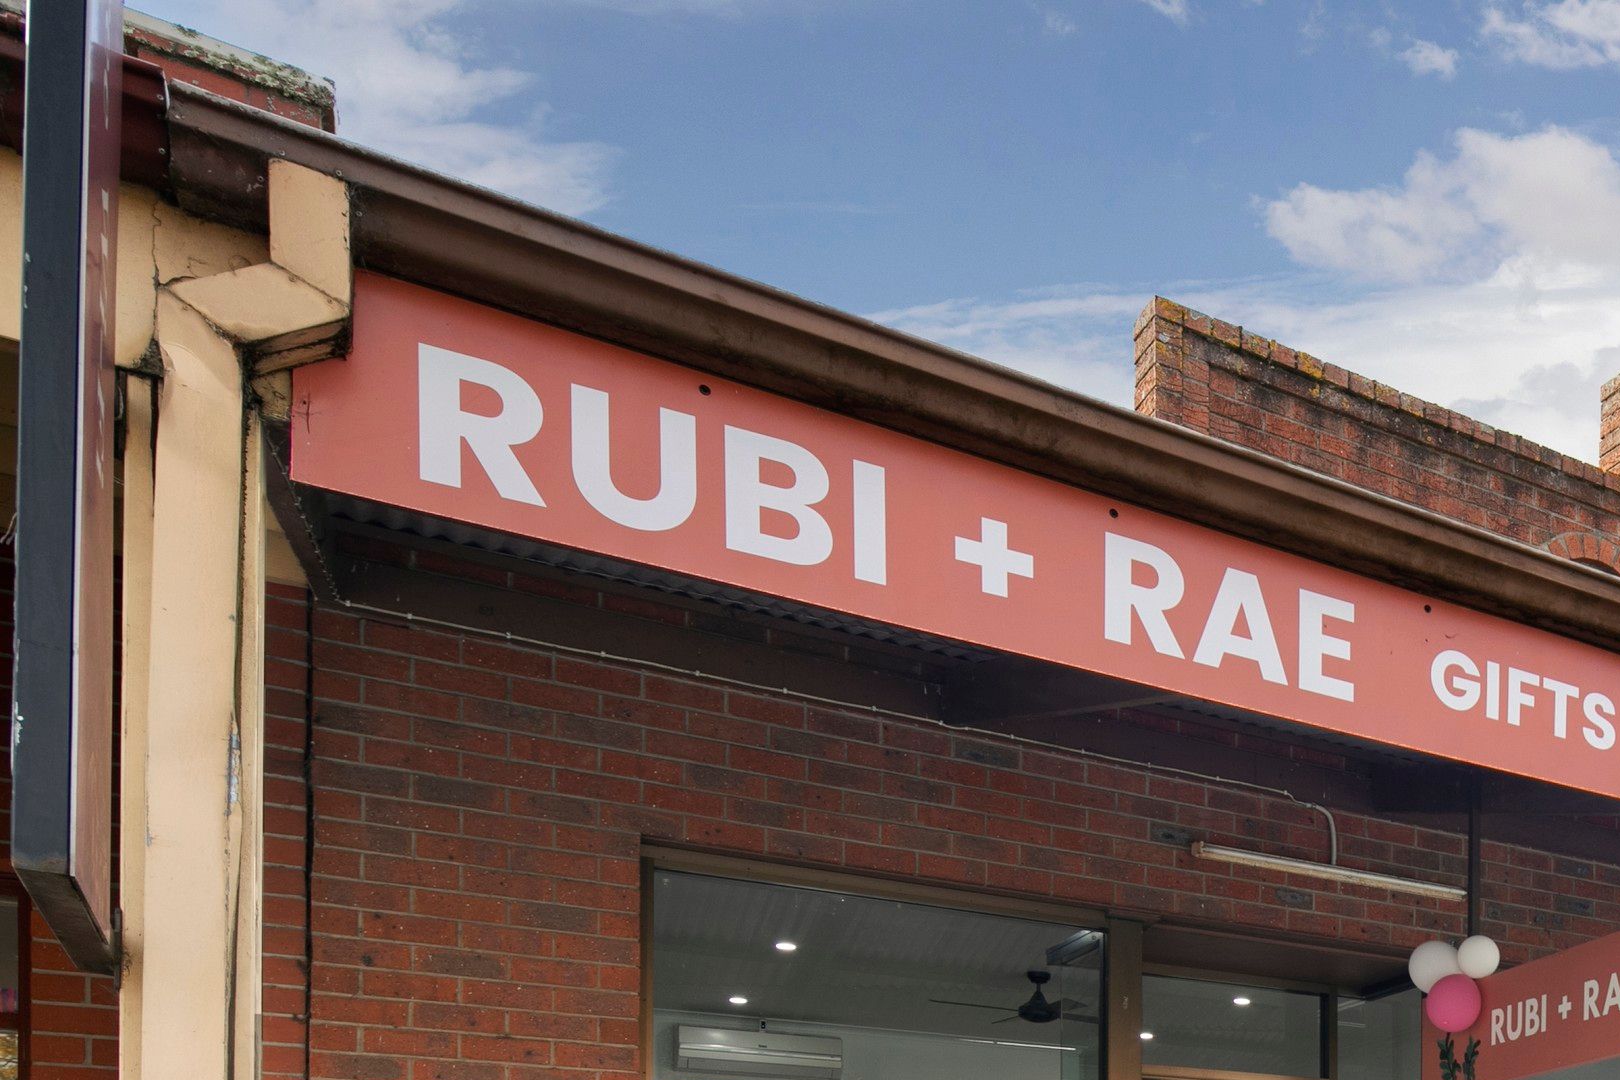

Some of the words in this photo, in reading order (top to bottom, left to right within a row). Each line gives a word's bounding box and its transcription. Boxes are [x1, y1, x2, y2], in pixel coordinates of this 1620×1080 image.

[416, 340, 888, 588] RUBI
[953, 517, 1034, 599] +
[1103, 530, 1356, 705] RAE
[1430, 649, 1616, 751] GIFTS
[1491, 993, 1547, 1046] RUBI
[1558, 995, 1572, 1021] +
